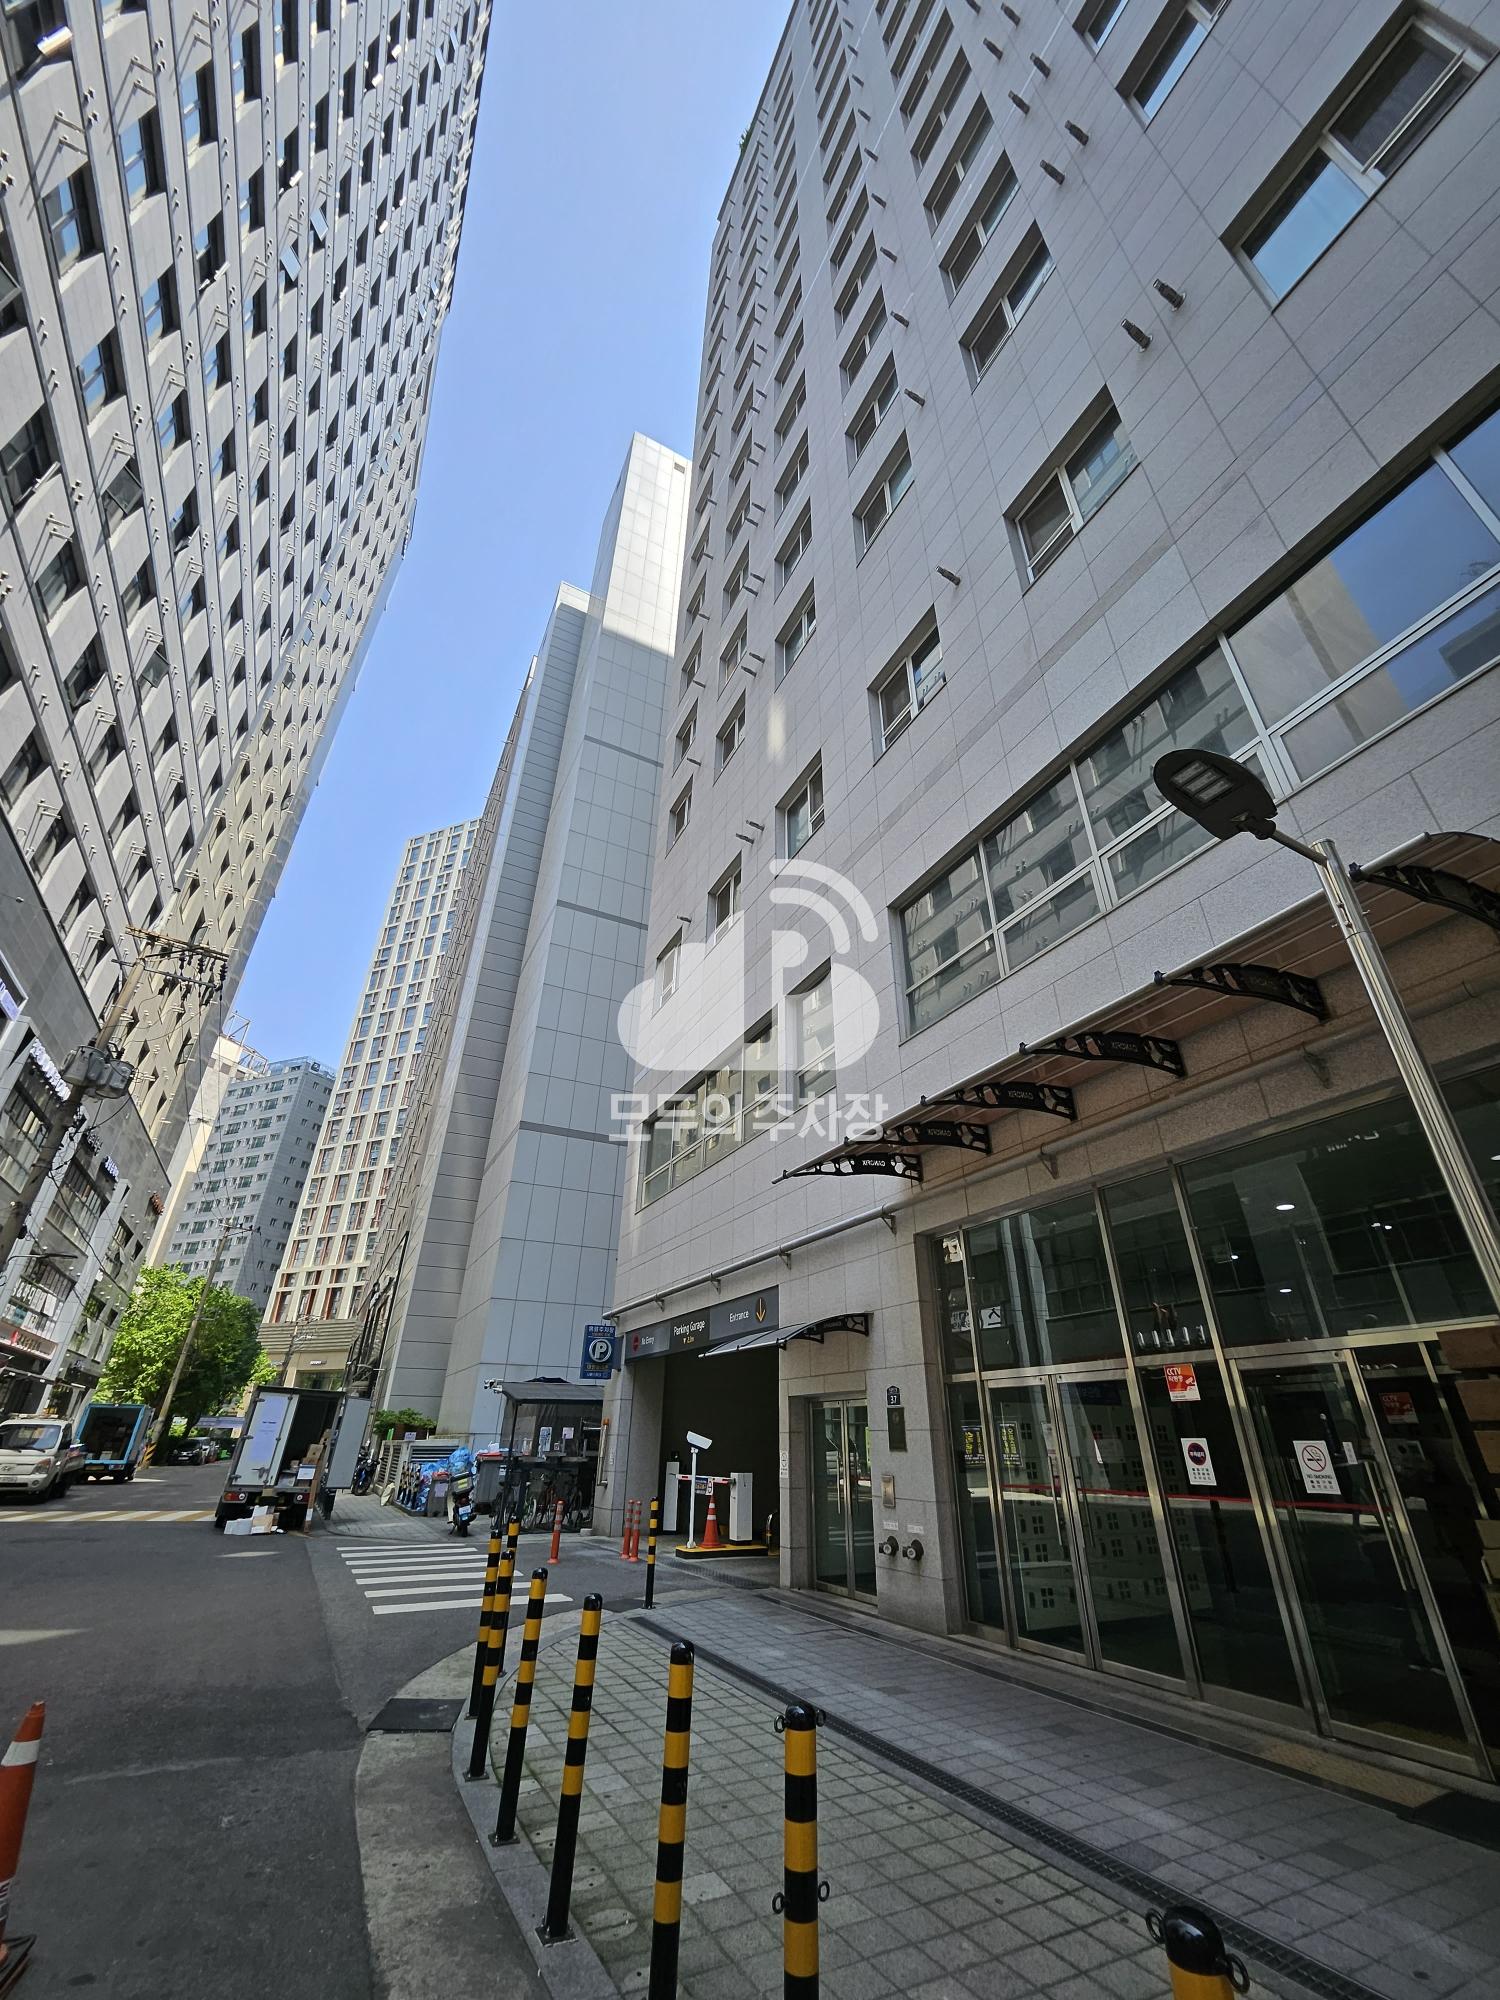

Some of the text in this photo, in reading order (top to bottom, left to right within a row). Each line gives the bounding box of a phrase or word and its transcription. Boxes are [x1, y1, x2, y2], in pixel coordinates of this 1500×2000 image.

[729, 1312, 749, 1322] Entrance
[673, 1319, 706, 1336] Parking Garage
[1166, 1367, 1181, 1376] CCTV
[890, 1395, 897, 1404] 37
